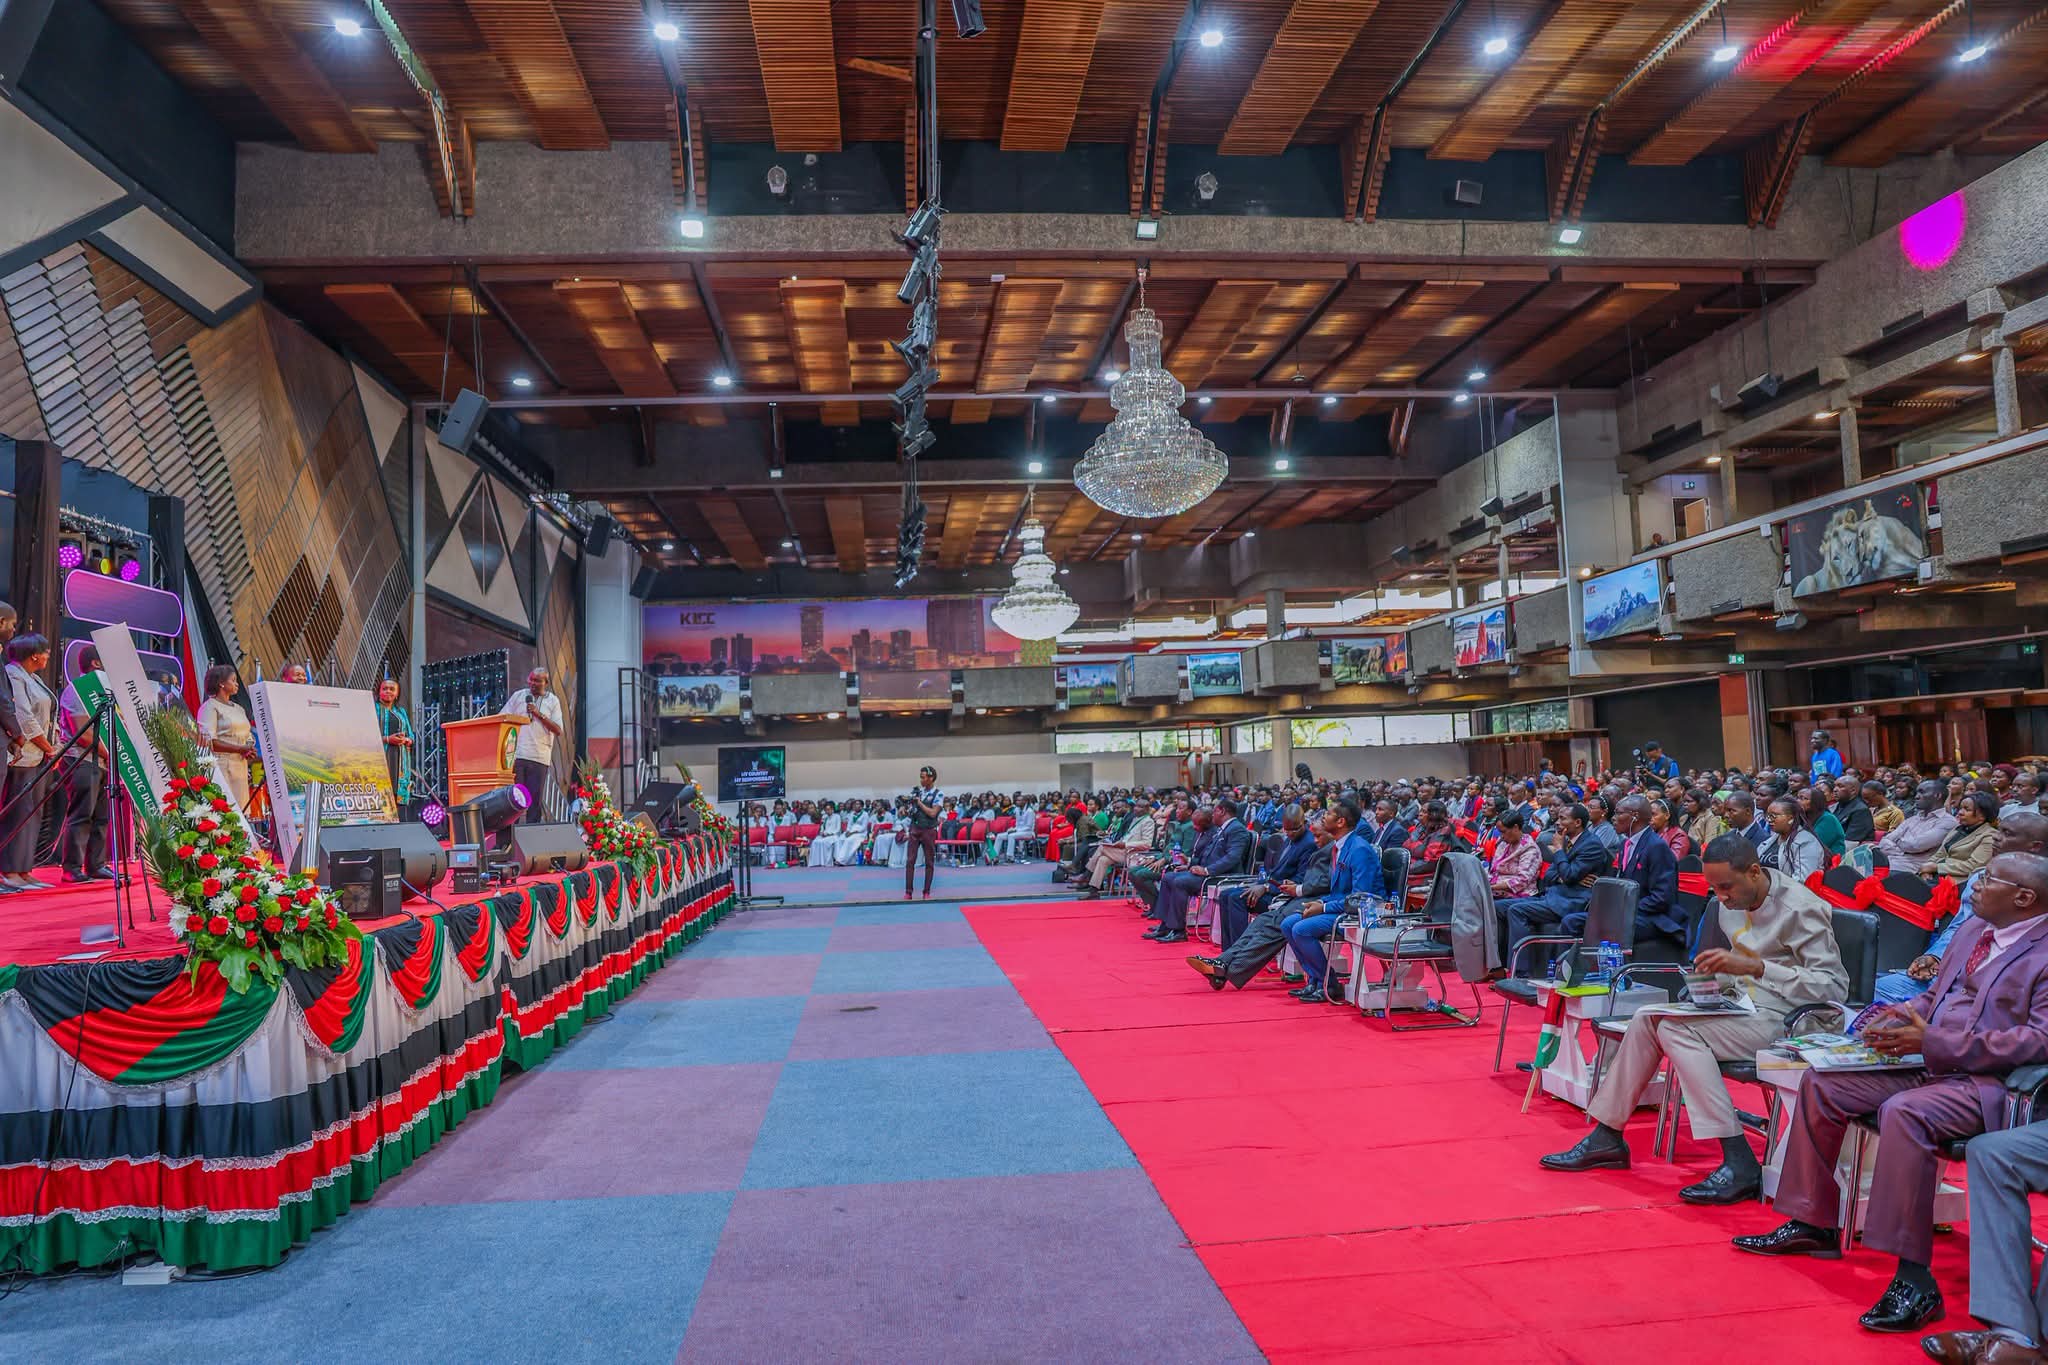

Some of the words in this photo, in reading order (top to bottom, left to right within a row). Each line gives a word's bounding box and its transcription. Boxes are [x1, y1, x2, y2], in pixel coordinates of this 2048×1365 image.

[259, 708, 271, 742] PROCESS
[267, 744, 273, 753] OF
[120, 752, 133, 765] OF
[127, 765, 146, 792] CIVIC
[270, 755, 279, 777] CIVIC
[274, 779, 282, 799] DUTY
[324, 783, 364, 794] PROCESS
[365, 784, 377, 794] OF
[345, 795, 380, 810] DUTY
